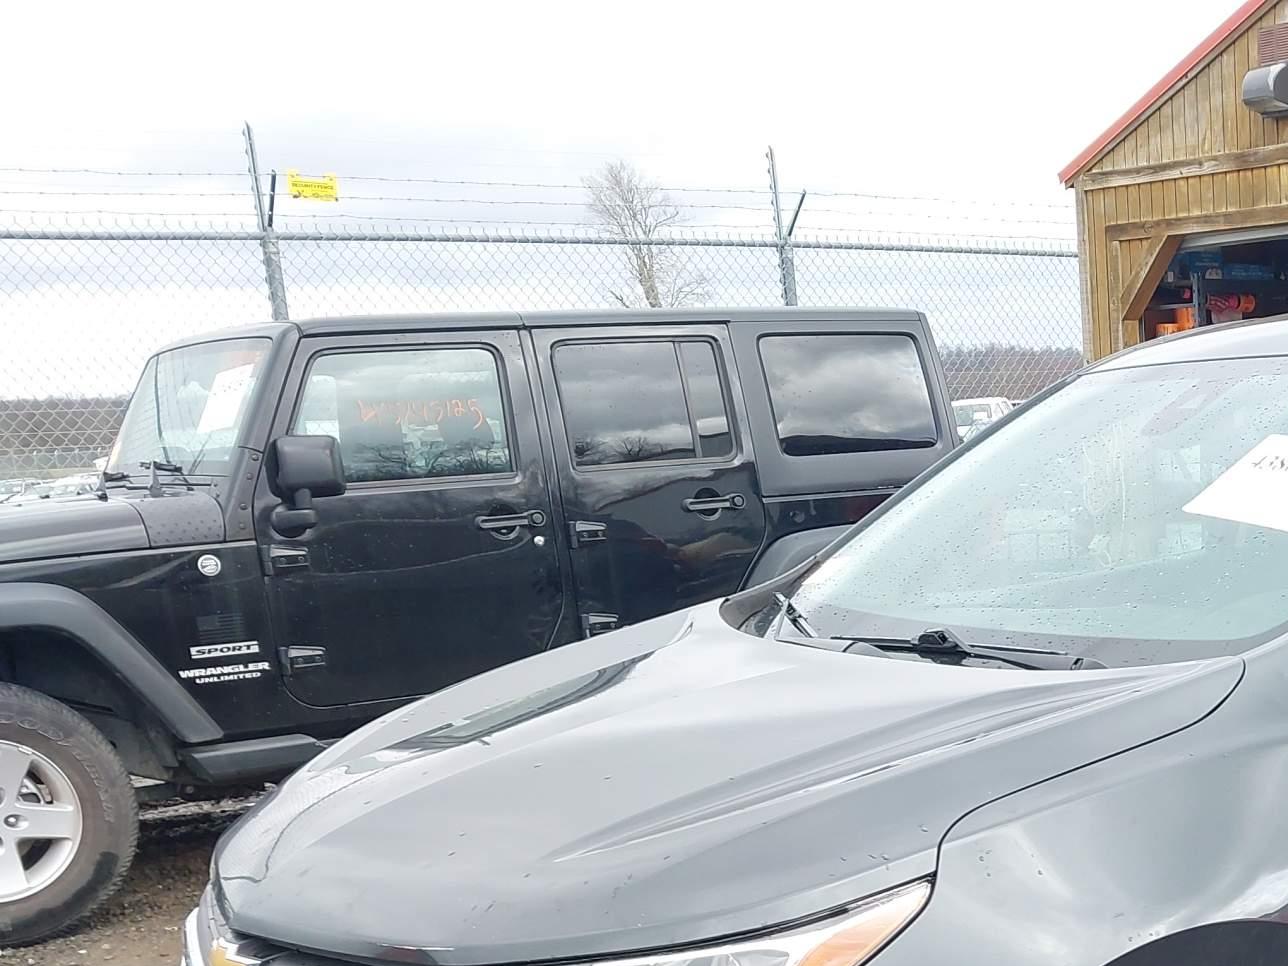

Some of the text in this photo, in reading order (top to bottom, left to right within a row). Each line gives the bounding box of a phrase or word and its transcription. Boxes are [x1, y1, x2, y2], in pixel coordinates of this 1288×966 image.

[195, 645, 252, 656] SPORT
[178, 661, 271, 678] WRANGLER
[195, 672, 262, 684] UNLIMITED
